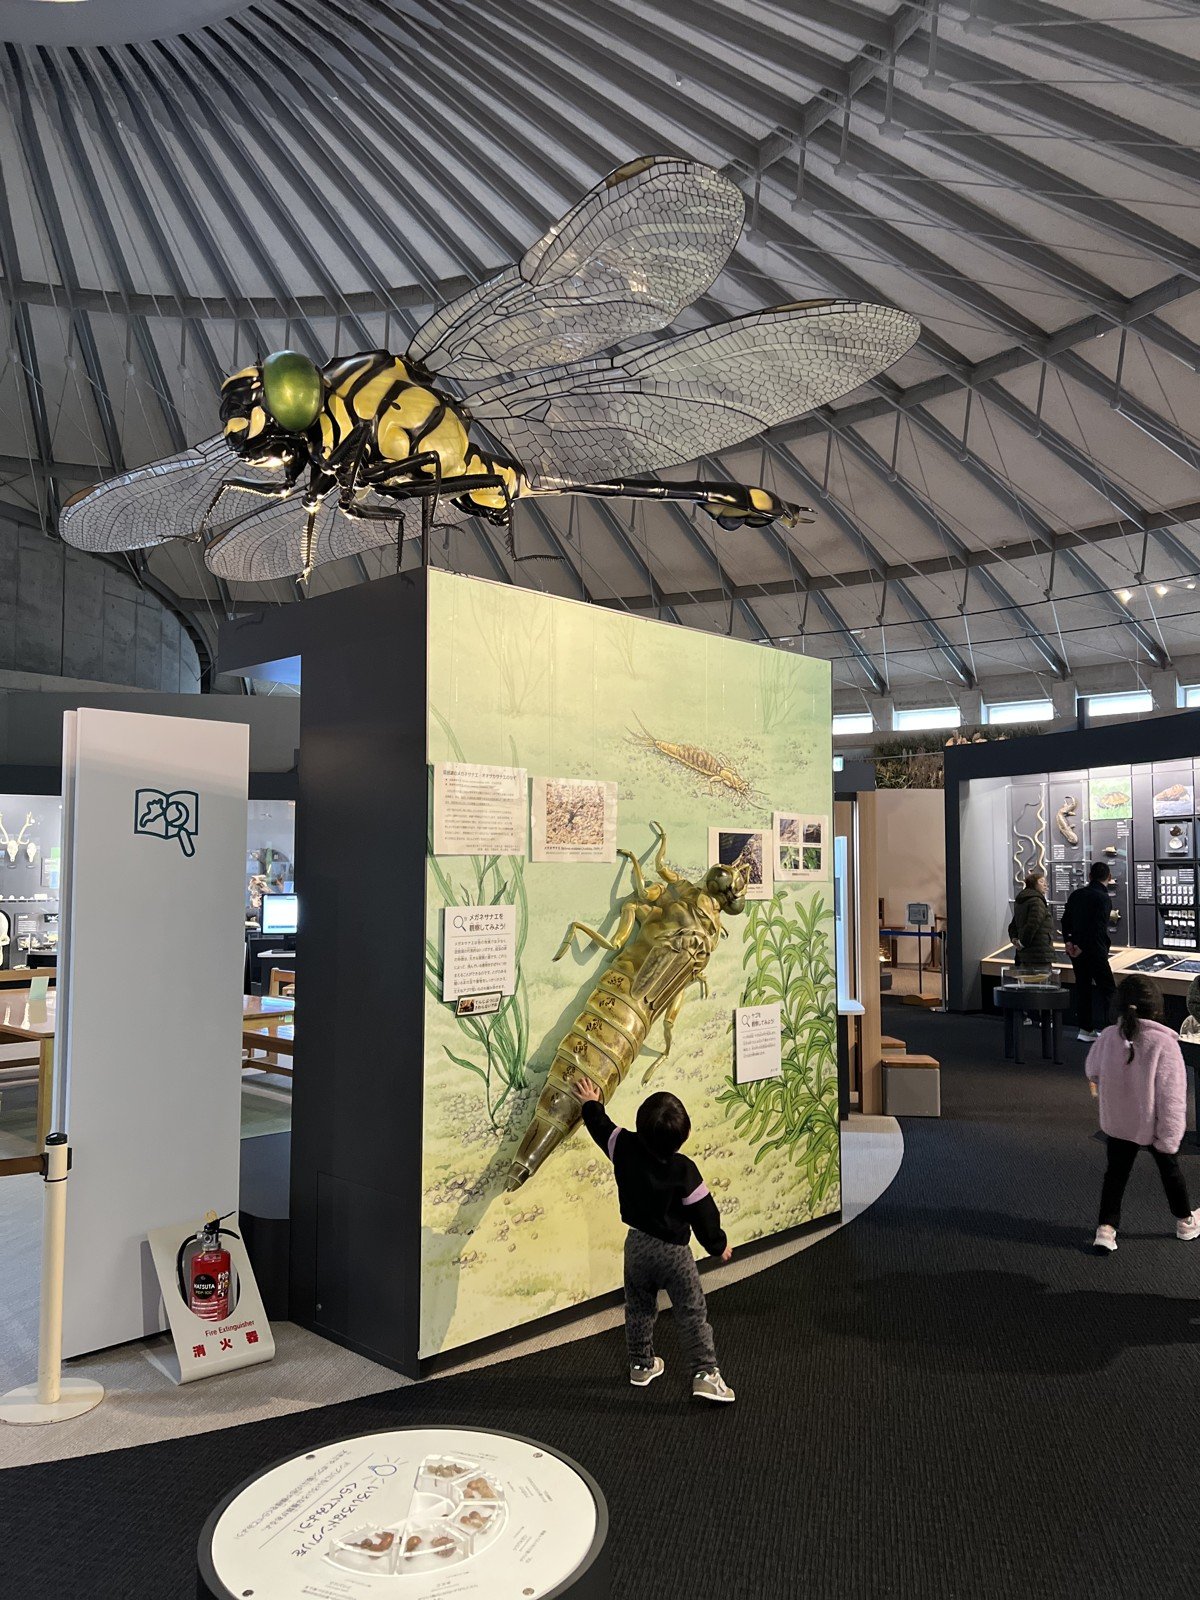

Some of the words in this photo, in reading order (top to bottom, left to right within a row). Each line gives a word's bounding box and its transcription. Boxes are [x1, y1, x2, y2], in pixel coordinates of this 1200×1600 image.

[469, 913, 504, 921] メガネサナエを
[204, 1329, 218, 1337] Fire
[218, 1320, 255, 1334] Extinguisher
[291, 1485, 379, 1557] いろいろなドングリを
[293, 1482, 357, 1533] くらべてみよう!
